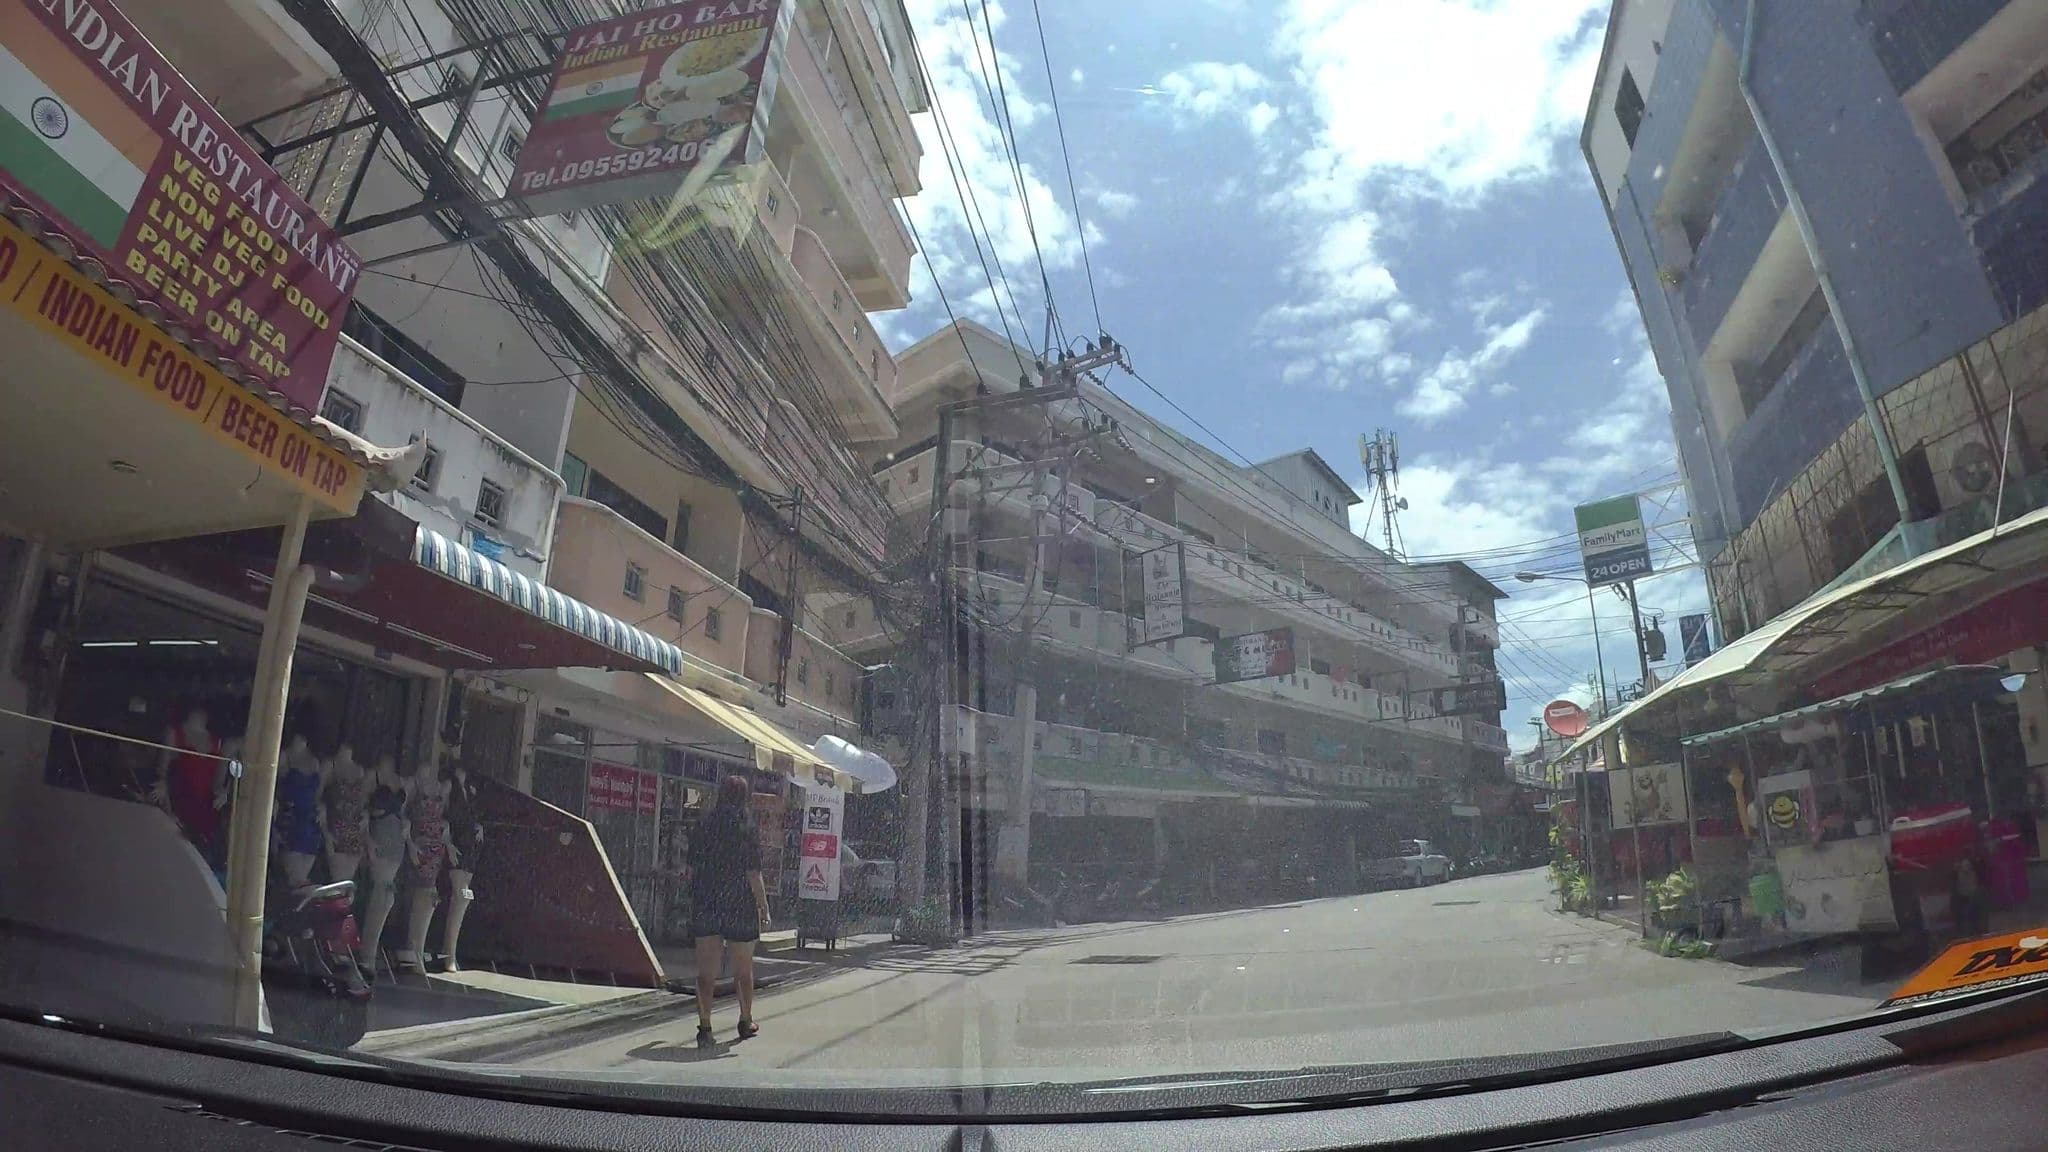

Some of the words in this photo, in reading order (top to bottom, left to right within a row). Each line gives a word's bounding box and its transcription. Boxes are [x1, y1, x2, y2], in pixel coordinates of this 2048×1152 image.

[561, 43, 630, 69] Indian
[639, 15, 765, 52] Restaurant
[570, 26, 624, 52] JAI
[633, 13, 684, 37] HO
[695, 0, 768, 24] BAR
[38, 0, 172, 117] NDIAN
[168, 98, 357, 294] RESTAURANT
[147, 203, 205, 259] LIVE
[213, 253, 245, 287] DJ
[159, 175, 214, 231] NON
[222, 229, 266, 277] VEG
[272, 272, 329, 331] FOOD
[172, 150, 220, 205] VEG
[226, 202, 288, 266] FOOD
[126, 250, 199, 315] BEER
[205, 310, 241, 346] ON
[248, 339, 292, 379] TAP
[137, 226, 223, 299] PARTY
[226, 297, 287, 349] AREA
[39, 272, 141, 367] INDIAN
[139, 340, 207, 411] FOOD
[221, 395, 279, 458] BEER
[280, 434, 312, 478] ON
[313, 452, 349, 497] TAP
[1583, 527, 1641, 547] FamilyMart
